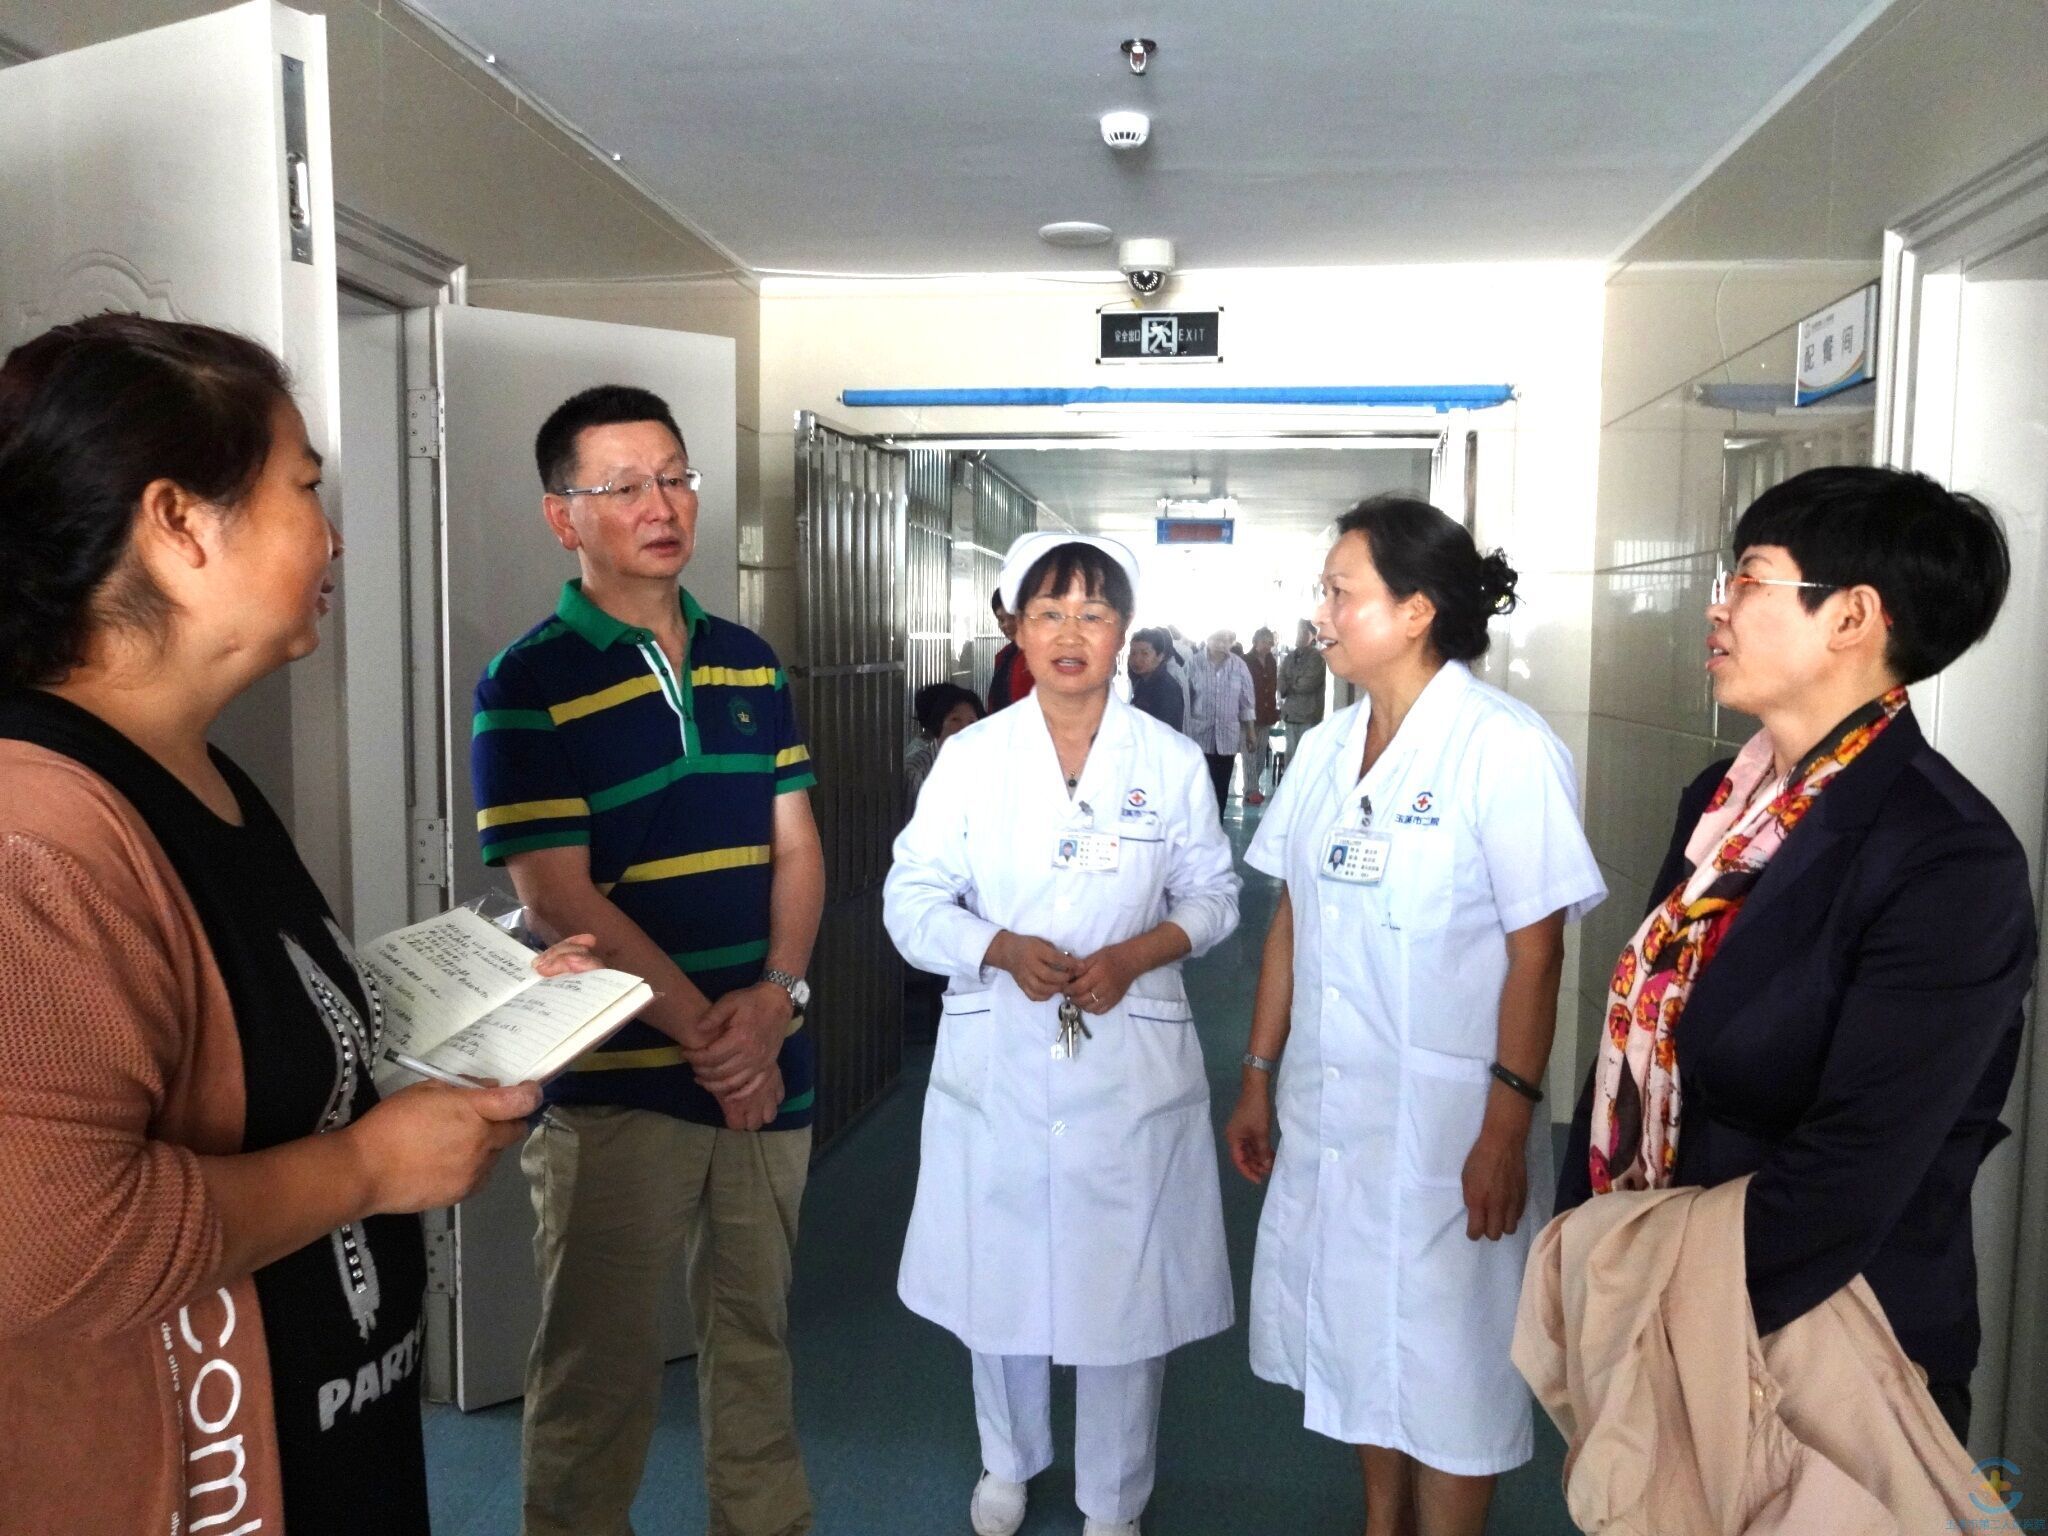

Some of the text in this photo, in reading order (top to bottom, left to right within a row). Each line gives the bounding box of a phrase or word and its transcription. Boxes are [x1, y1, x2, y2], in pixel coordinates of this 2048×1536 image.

[1114, 329, 1140, 343] 安全出口
[1178, 328, 1206, 342] EXIT
[1803, 324, 1854, 373] 配餐间
